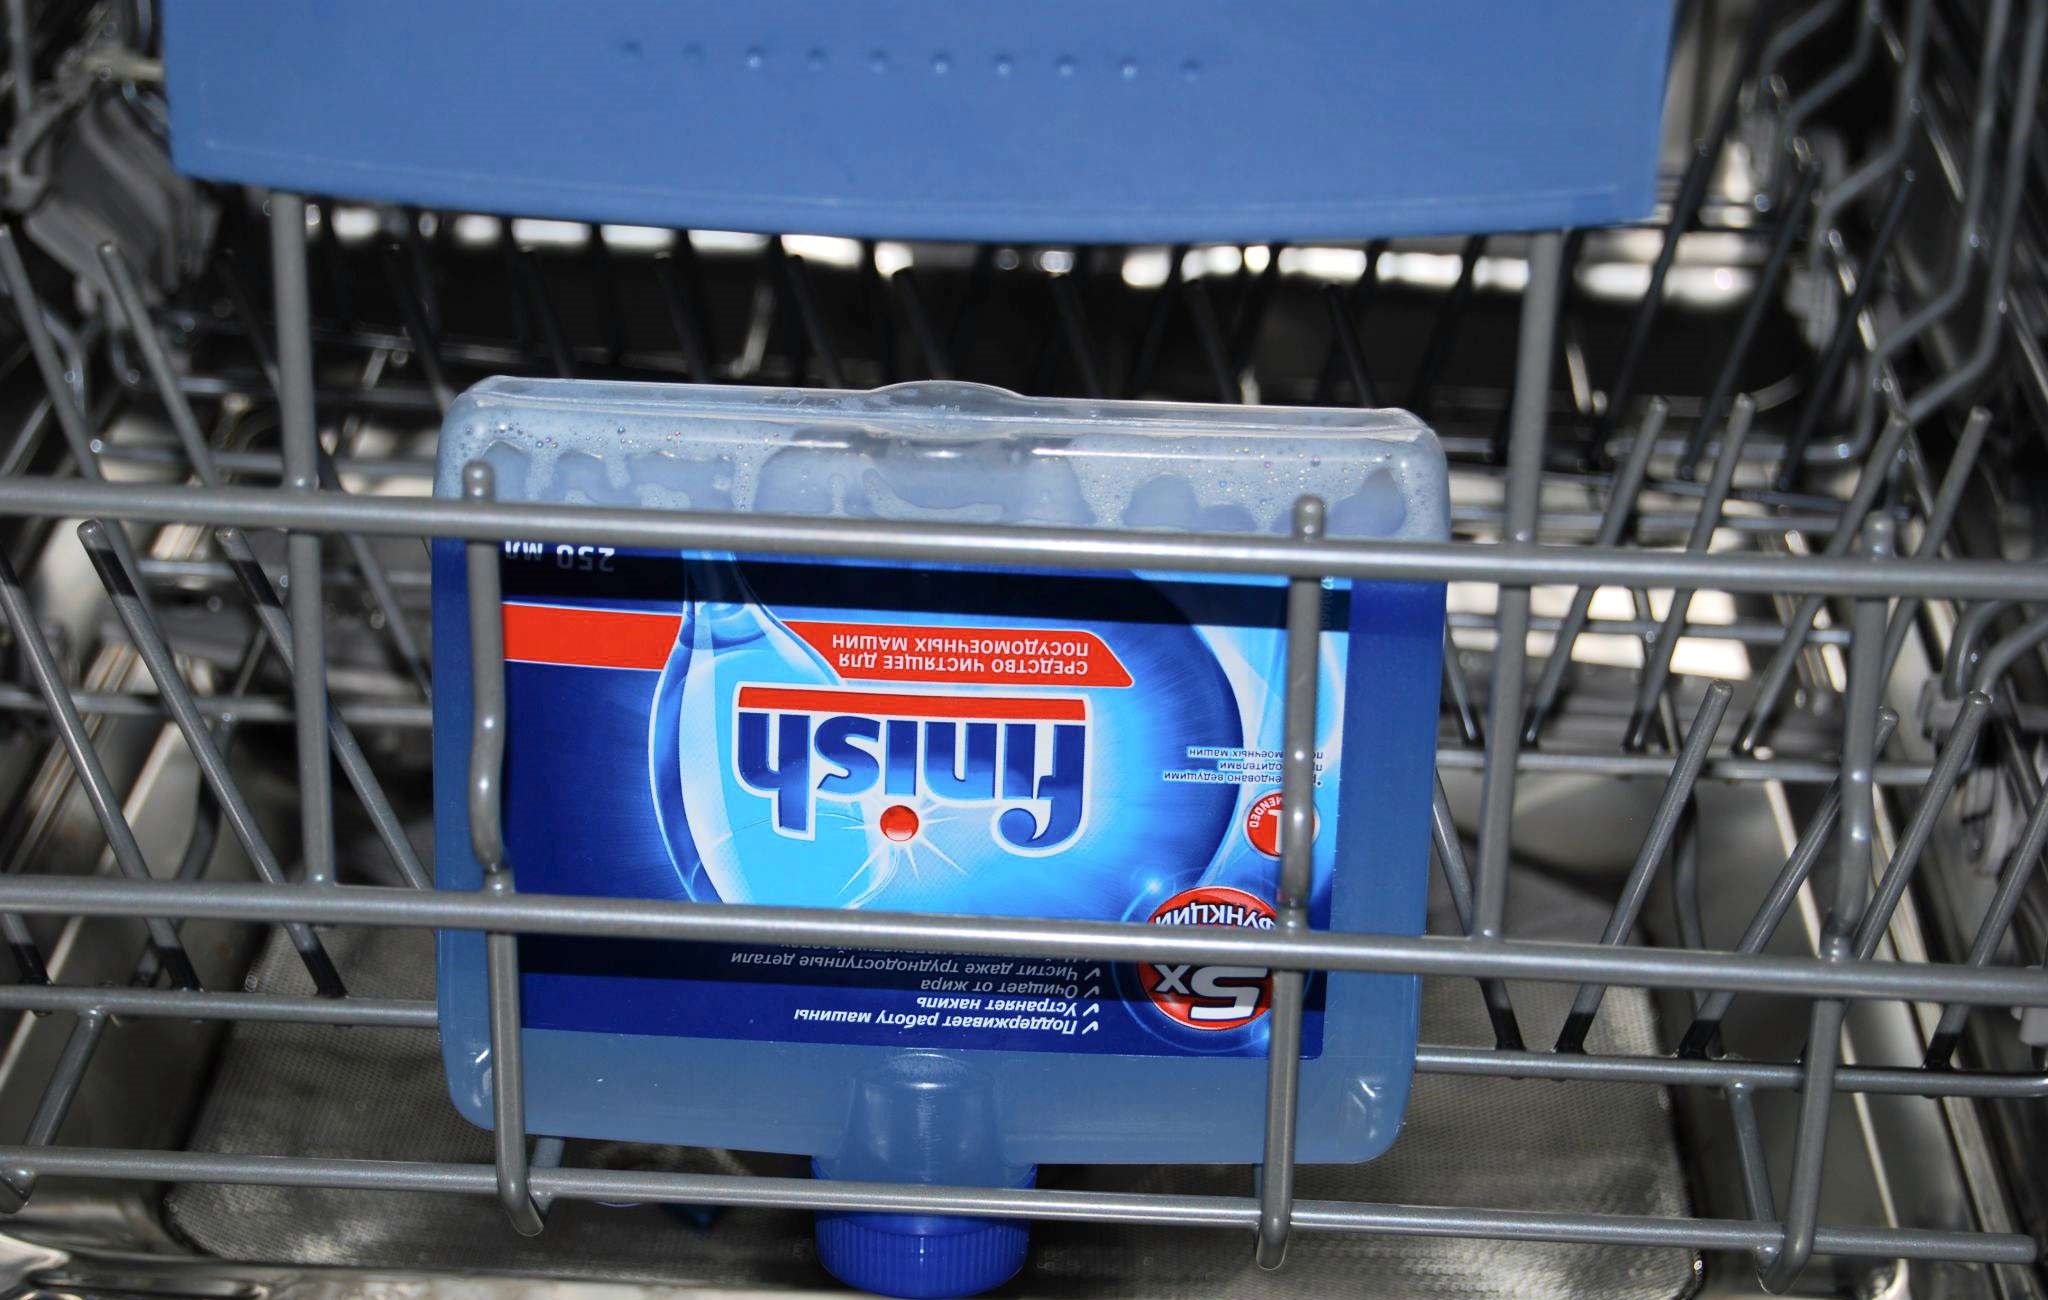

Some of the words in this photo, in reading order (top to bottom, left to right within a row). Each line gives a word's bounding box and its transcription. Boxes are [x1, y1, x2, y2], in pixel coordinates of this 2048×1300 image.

[556, 544, 615, 572] 250
[831, 634, 908, 651] МАШИН
[914, 638, 1089, 658] ПОСУДОМОЕЧНЫХ
[838, 653, 878, 667] ДЛЯ
[883, 654, 985, 673] ЧИСТЯЩЕЕ
[991, 656, 1088, 675] СРЕДСТВО
[1189, 749, 1228, 758] машин
[737, 711, 1088, 850] finish
[1164, 771, 1224, 782] ведущими
[730, 948, 796, 965] детали
[800, 954, 959, 974] труднодоступные
[965, 962, 1013, 975] даже
[1016, 965, 1079, 981] Чистит
[920, 979, 968, 991] жира
[971, 981, 993, 992] от
[997, 980, 1079, 999] Очищает
[916, 996, 981, 1010] накипь
[985, 998, 1077, 1017] Устраняет
[794, 1008, 871, 1023] машины
[874, 1011, 940, 1028] работу
[942, 1015, 1077, 1035] Поддерживает
